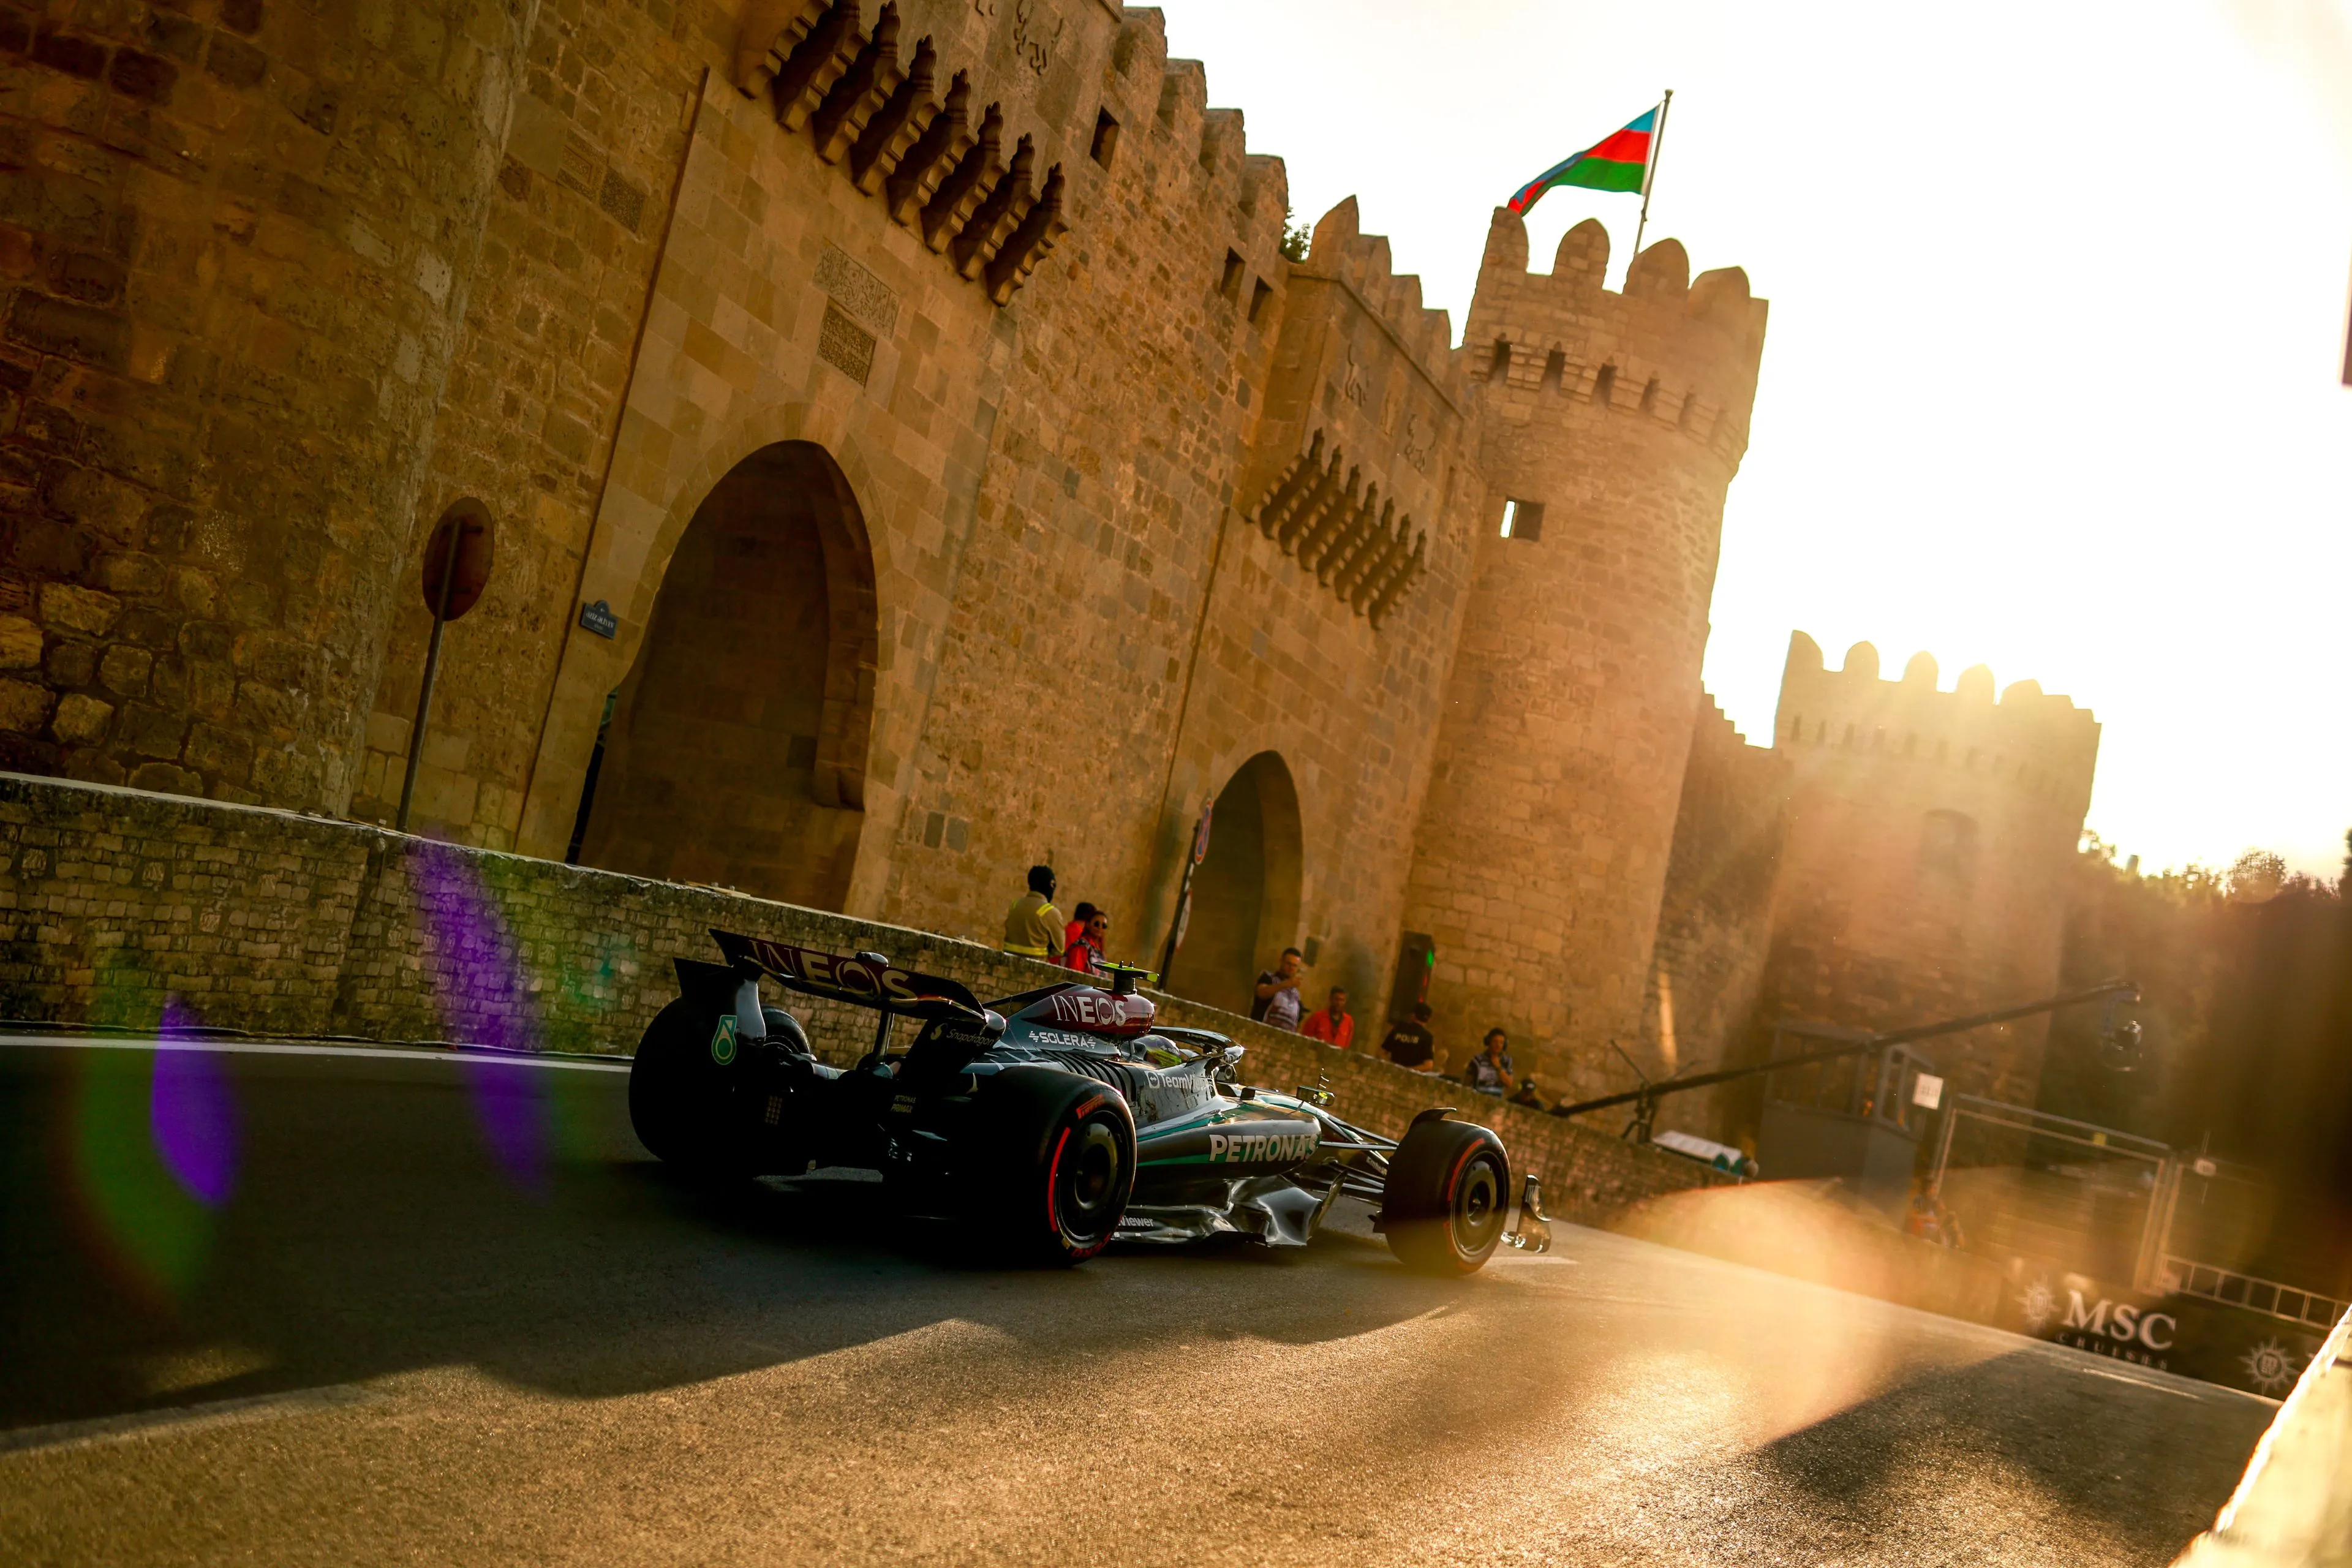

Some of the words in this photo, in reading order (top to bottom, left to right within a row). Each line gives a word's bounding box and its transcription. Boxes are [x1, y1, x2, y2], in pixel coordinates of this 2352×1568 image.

[748, 940, 918, 1006] INEOS
[1050, 995, 1126, 1027] INEOS
[946, 1029, 995, 1047] Snapdragon
[1039, 1031, 1089, 1048] SOLERA
[1209, 1134, 1318, 1163] PETRONAS
[2059, 1289, 2176, 1350] MSC
